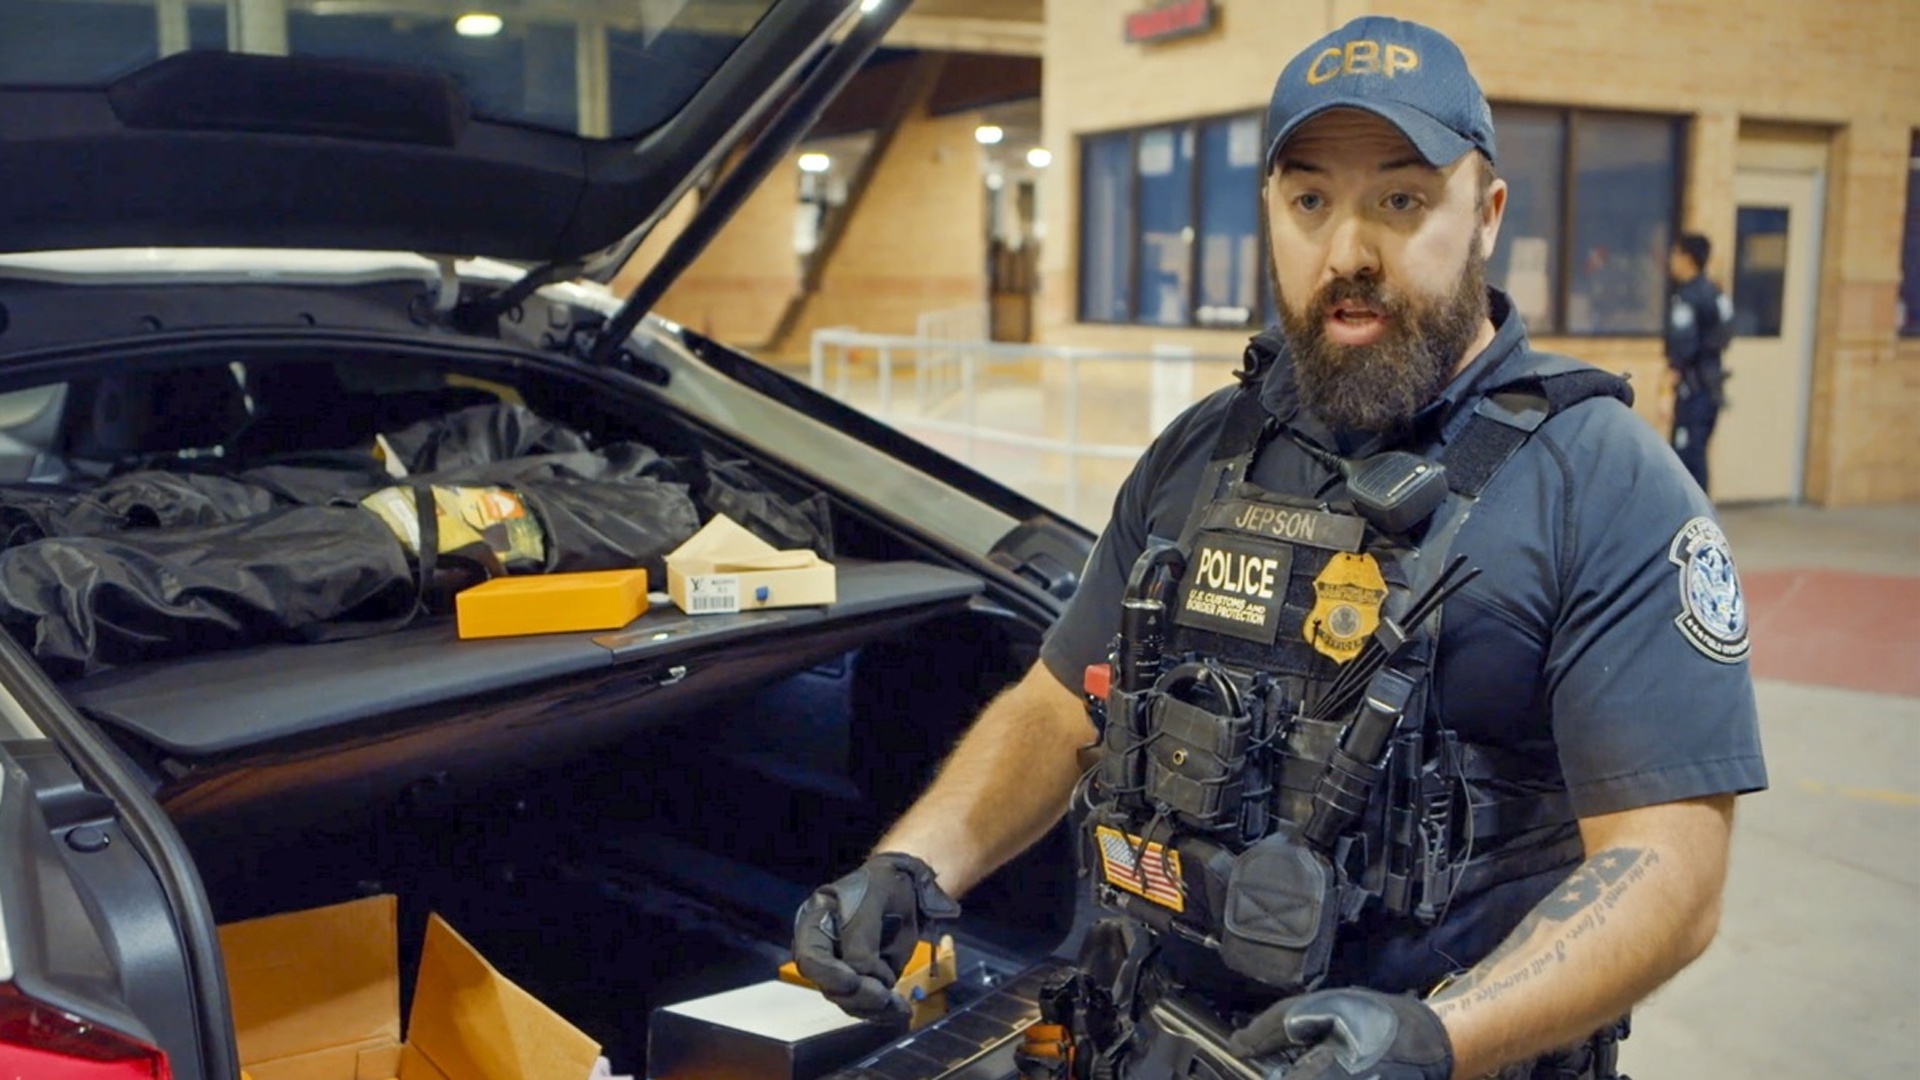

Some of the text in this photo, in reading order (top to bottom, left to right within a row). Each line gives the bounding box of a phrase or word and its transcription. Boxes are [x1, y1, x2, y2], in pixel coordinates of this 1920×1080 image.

[1306, 40, 1419, 85] CBP
[1235, 505, 1317, 540] JEPSON
[1195, 548, 1278, 598] POLICE
[1186, 598, 1266, 626] BORDER PROTECTION
[1204, 592, 1246, 611] CUSTOMS
[1245, 603, 1266, 614] AND
[1530, 951, 1554, 976] will
